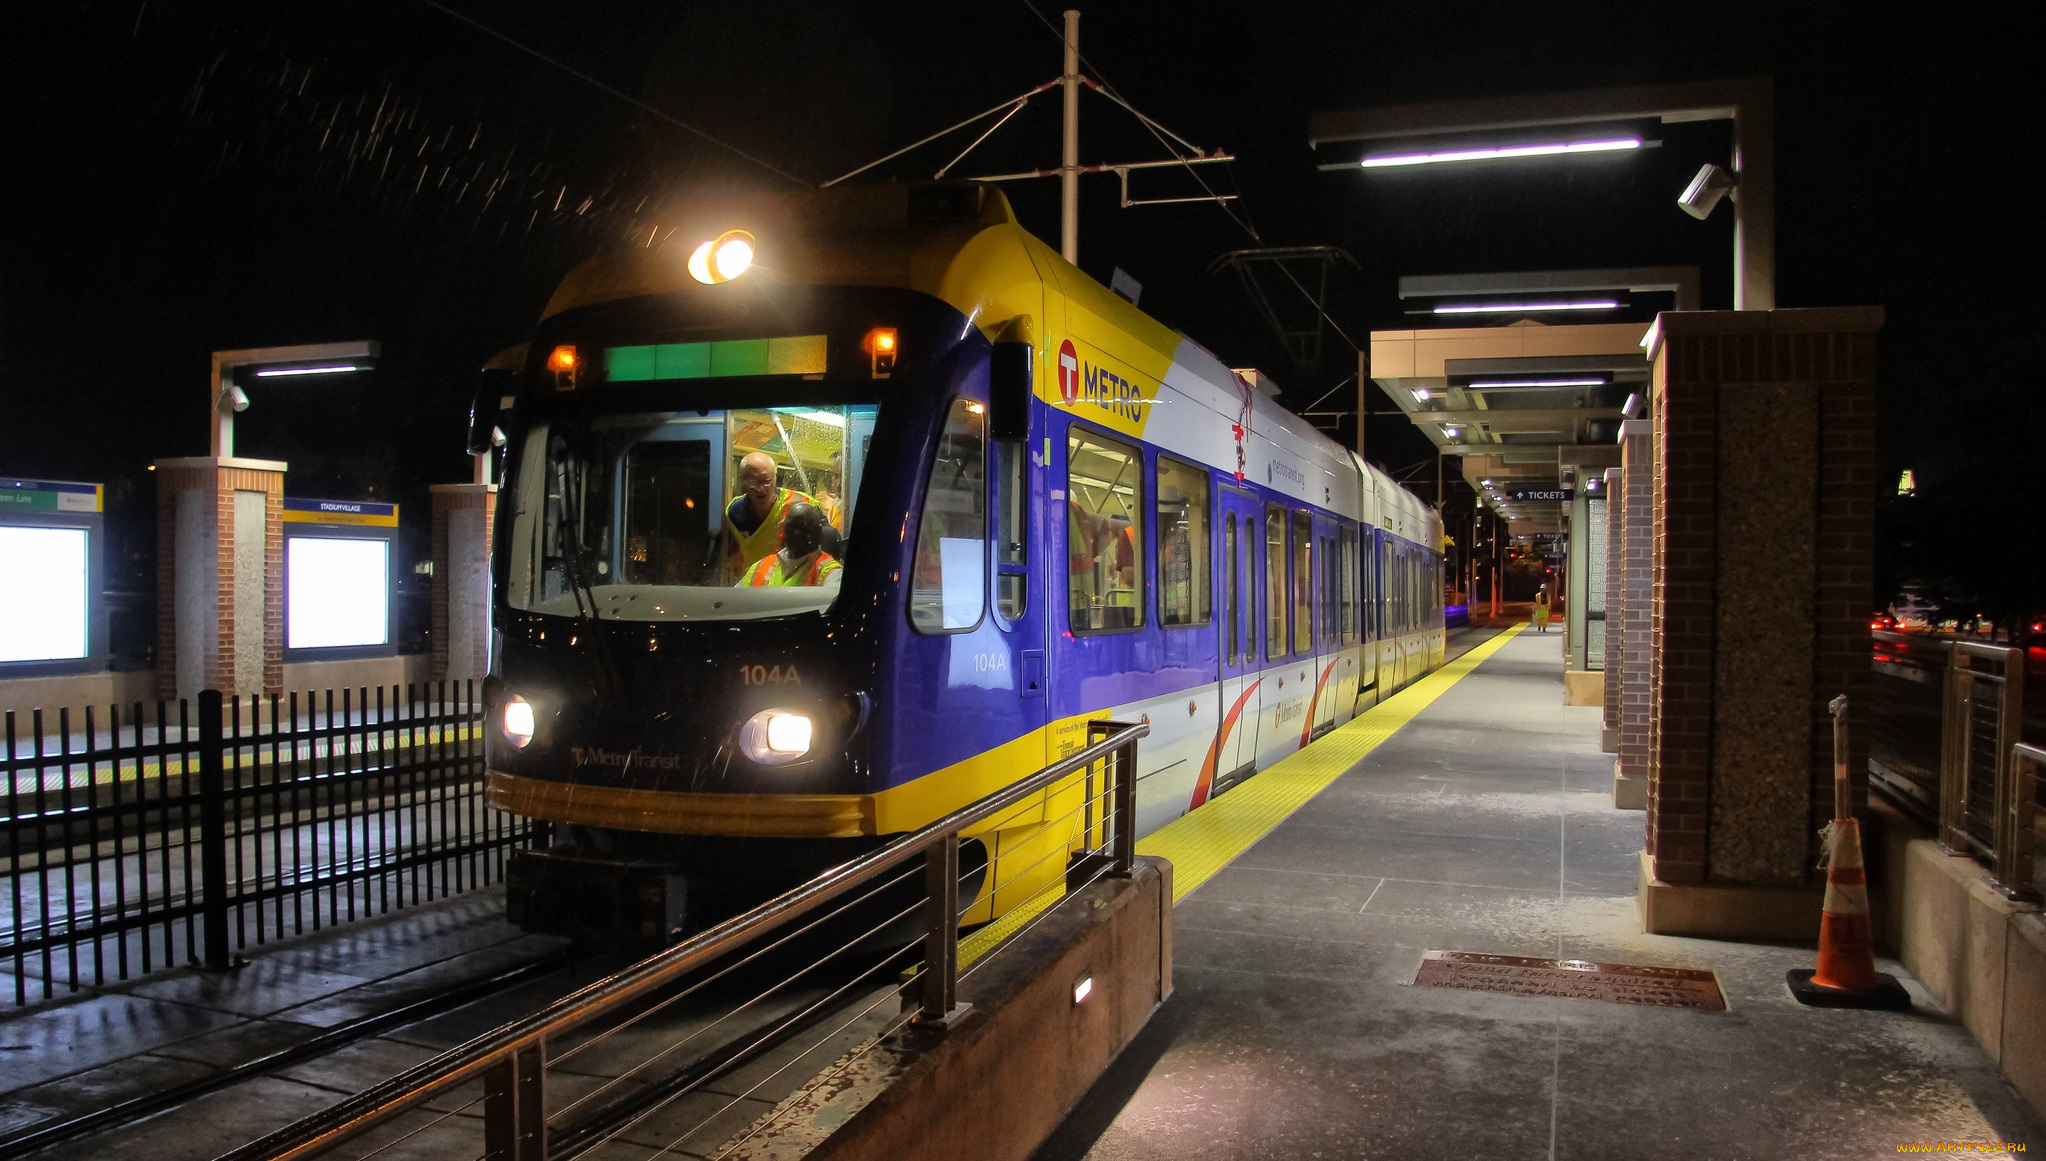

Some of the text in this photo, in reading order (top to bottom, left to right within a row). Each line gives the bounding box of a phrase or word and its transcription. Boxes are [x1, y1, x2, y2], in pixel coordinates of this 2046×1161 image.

[1084, 360, 1141, 423] METRO
[1528, 491, 1565, 500] TICKETS
[320, 503, 360, 513] STADIUM VILLAGE
[973, 653, 1006, 672] 104A
[740, 664, 801, 686] 104A
[588, 747, 630, 767] Metro
[631, 749, 680, 769] Transit
